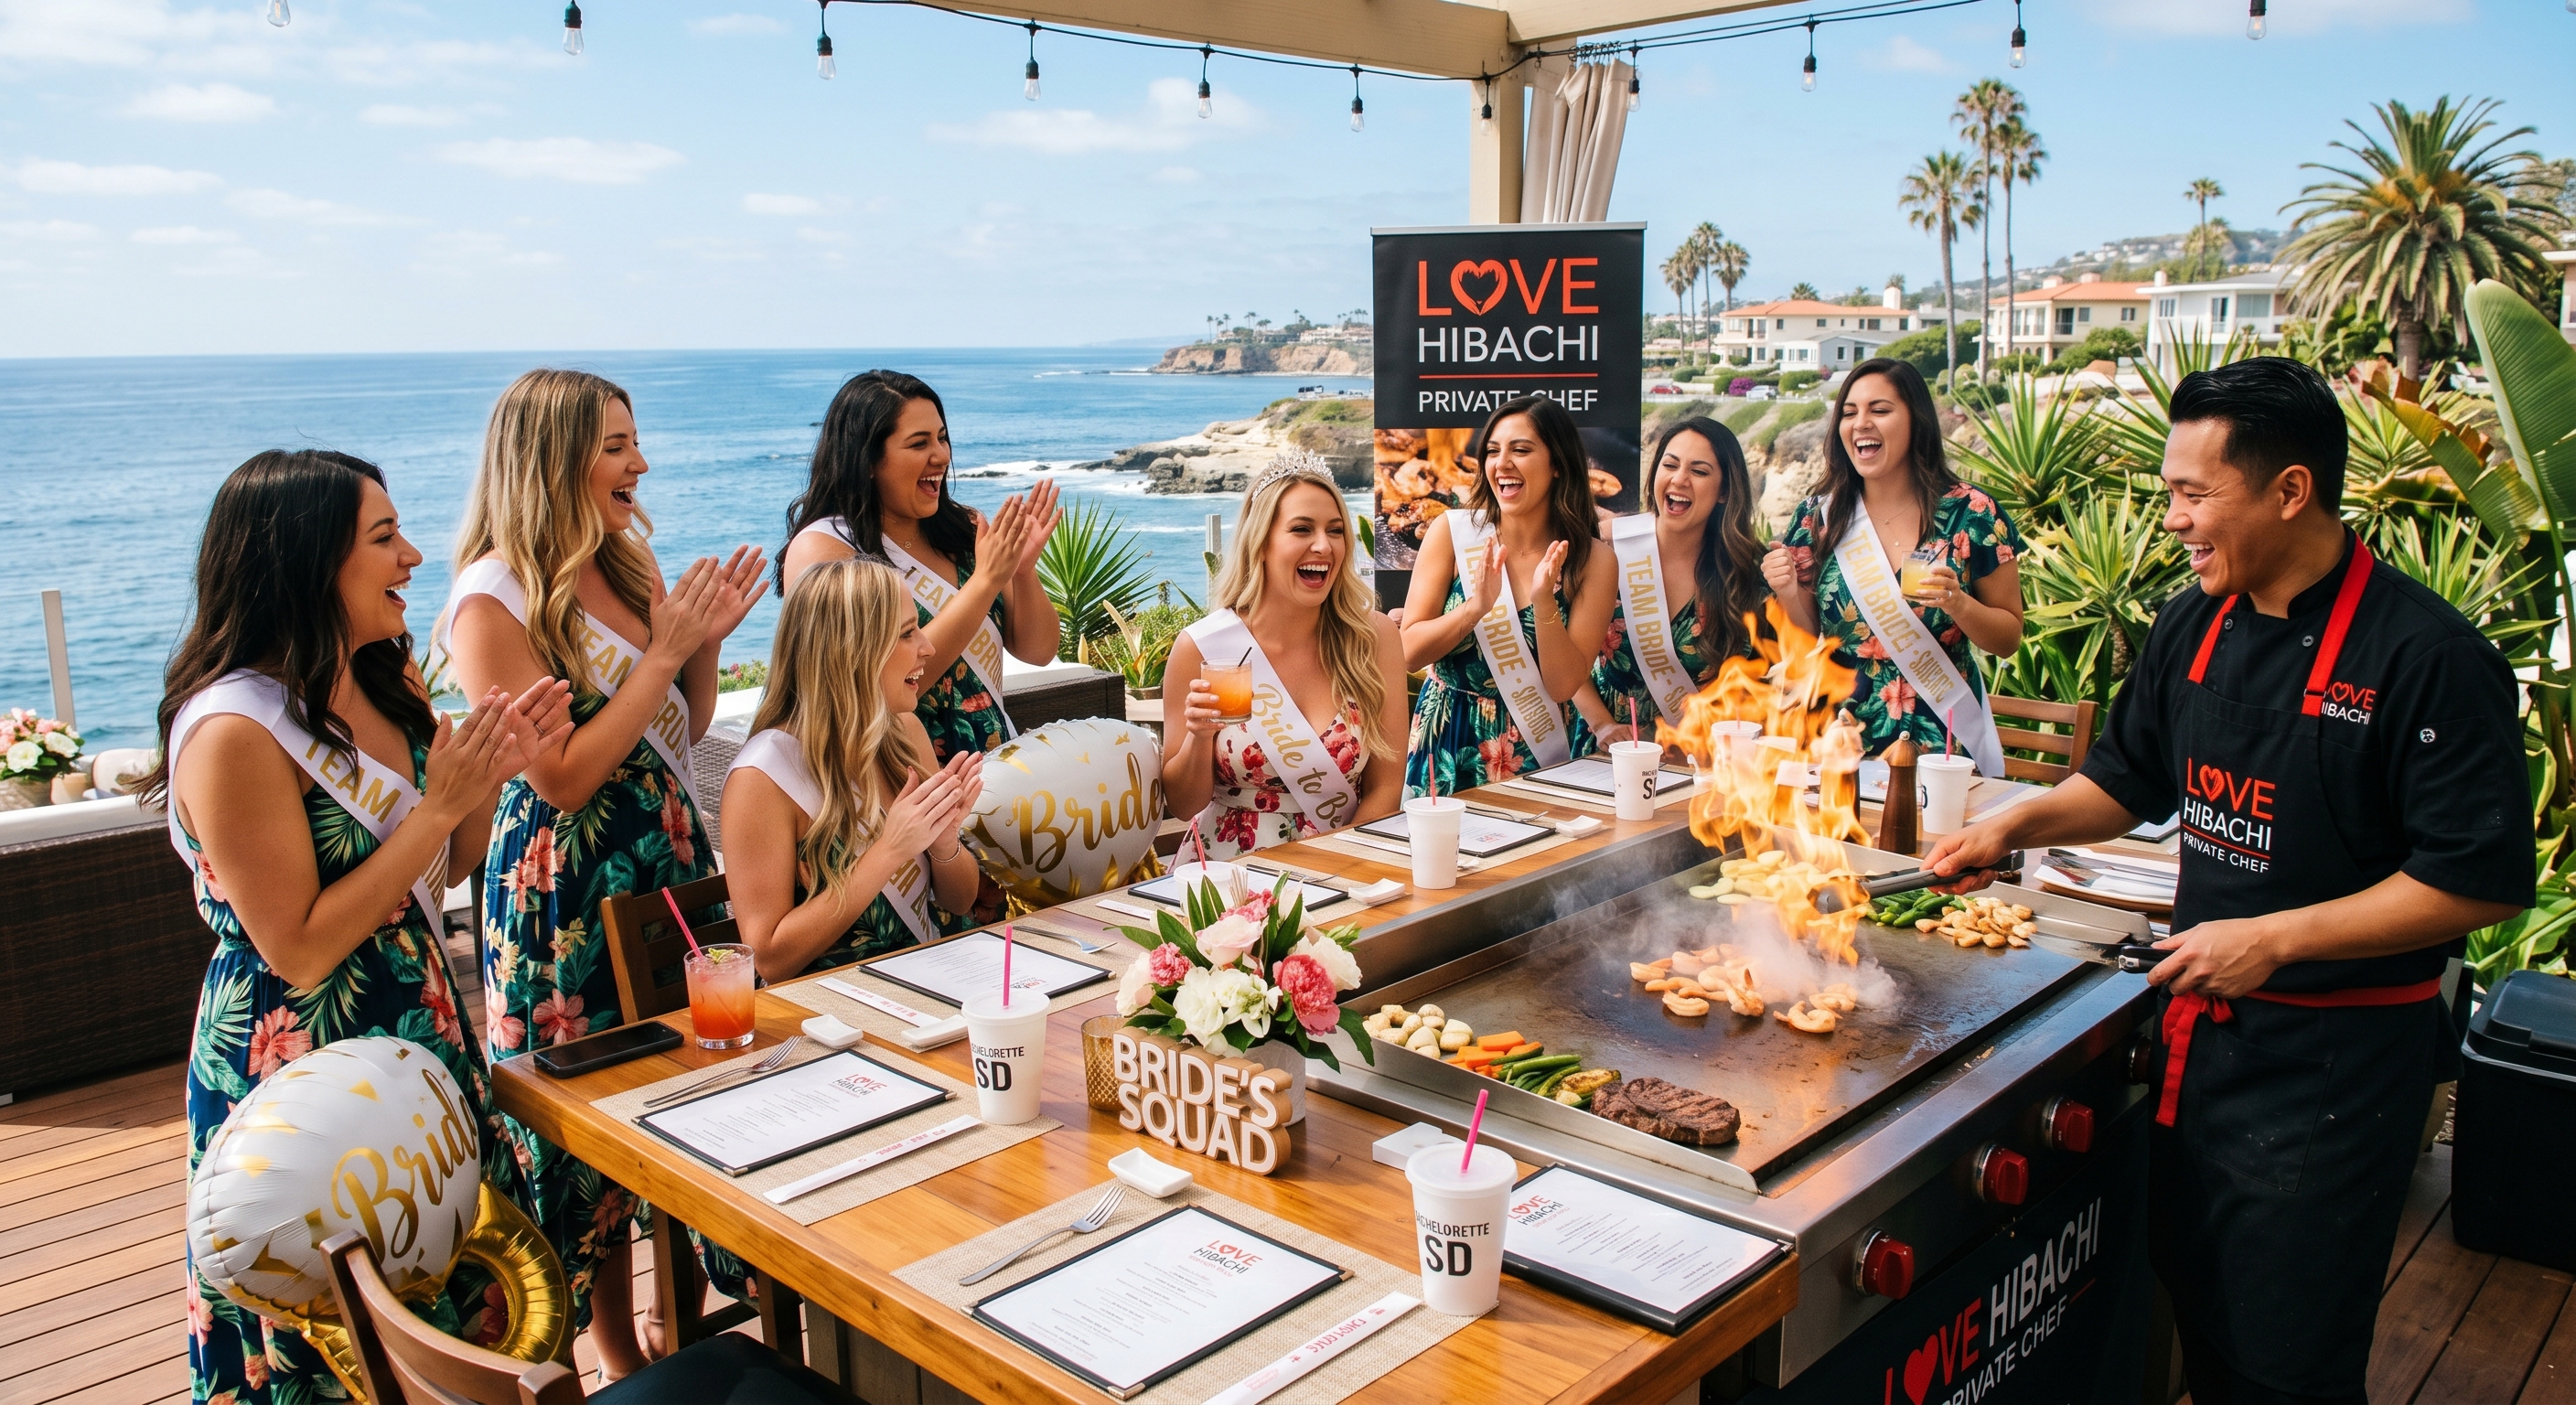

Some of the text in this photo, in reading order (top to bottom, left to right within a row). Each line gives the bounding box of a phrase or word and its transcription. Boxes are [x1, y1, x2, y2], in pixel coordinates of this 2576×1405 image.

[1418, 257, 1599, 316] LOVE
[1418, 325, 1599, 363] HIBACHI
[1530, 389, 1599, 412] HEF
[904, 565, 955, 612] TEA
[1626, 554, 1659, 618] TEAM
[1841, 530, 1886, 591] TEAM
[1481, 604, 1527, 676] BRIDE
[1635, 620, 1677, 681] BRIDE
[2321, 701, 2371, 725] IBACHI
[2326, 681, 2377, 712] OVE
[1250, 682, 1349, 830] Bride to Be
[1004, 751, 1164, 874] Bride
[1642, 777, 1658, 800] S
[2186, 756, 2276, 820] LOVE
[2183, 796, 2271, 852] HIBACHI
[2184, 831, 2270, 874] PRIVATE CHEF
[975, 1057, 1013, 1092] SD
[1112, 1033, 1278, 1129] BRIDE'S
[1117, 1082, 1278, 1174] SQUAD
[1507, 1195, 1551, 1220] LOVE
[1207, 1239, 1263, 1267] LOVE
[1424, 1234, 1473, 1277] SD
[1988, 1196, 2102, 1348] HIBACHI
[1941, 1293, 2068, 1405] RIVATE CHEF
